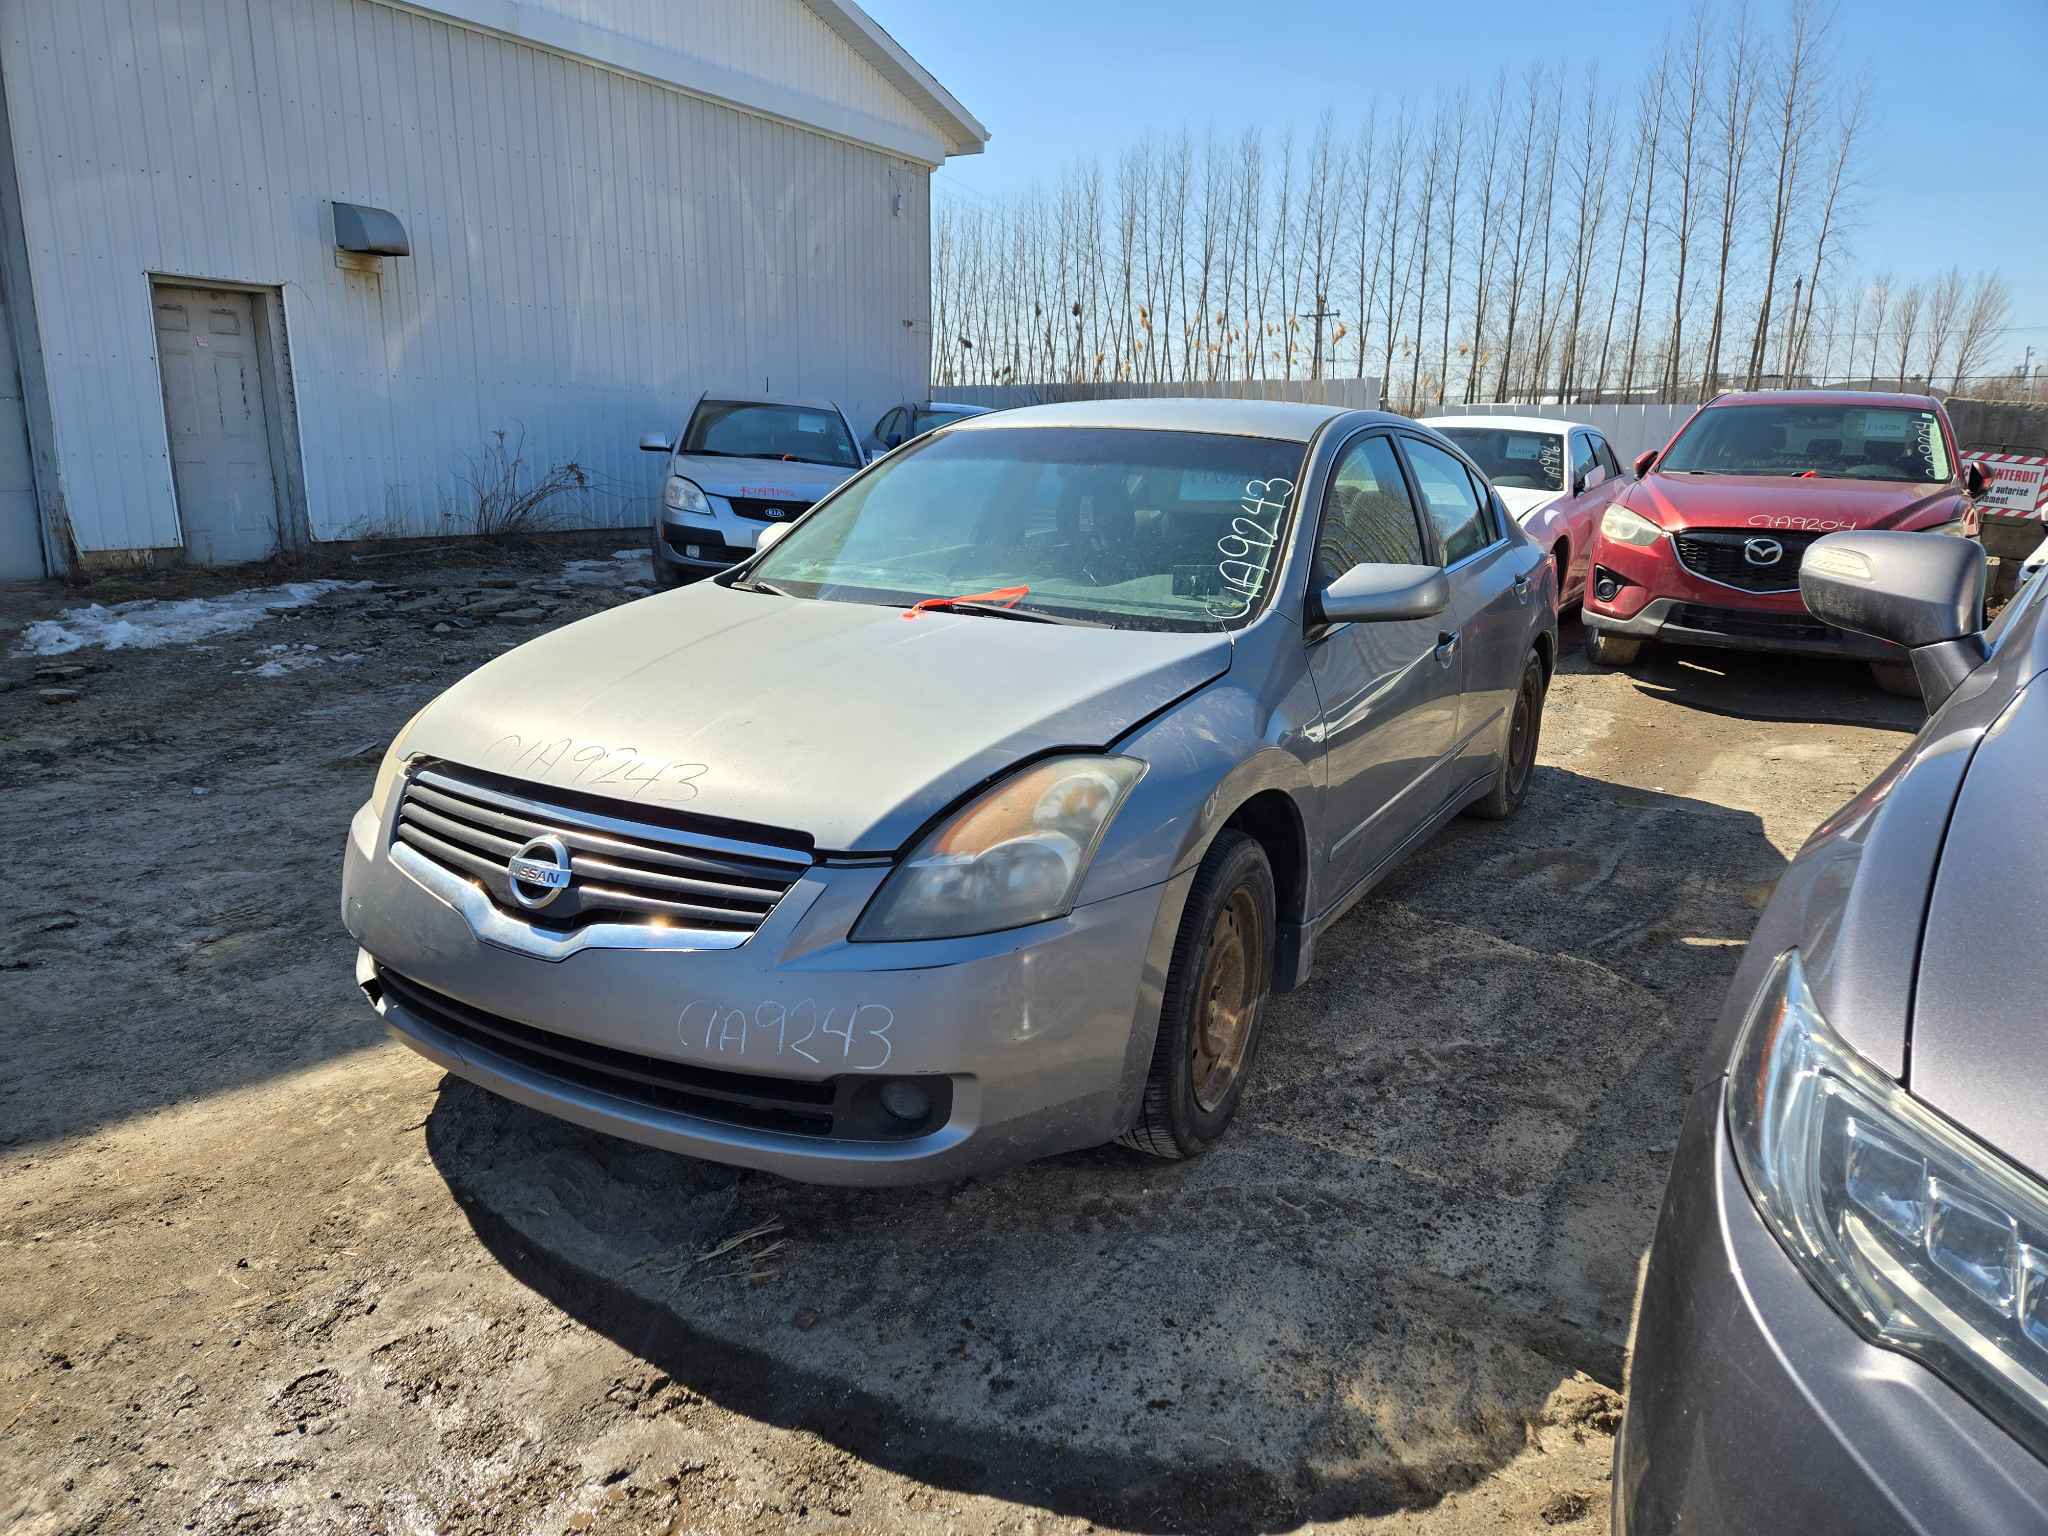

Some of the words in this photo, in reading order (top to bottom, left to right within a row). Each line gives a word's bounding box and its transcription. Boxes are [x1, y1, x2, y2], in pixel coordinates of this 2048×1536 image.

[1995, 486, 2029, 497] autorisé
[767, 509, 782, 517] KIA
[511, 863, 560, 884] NISSAN
